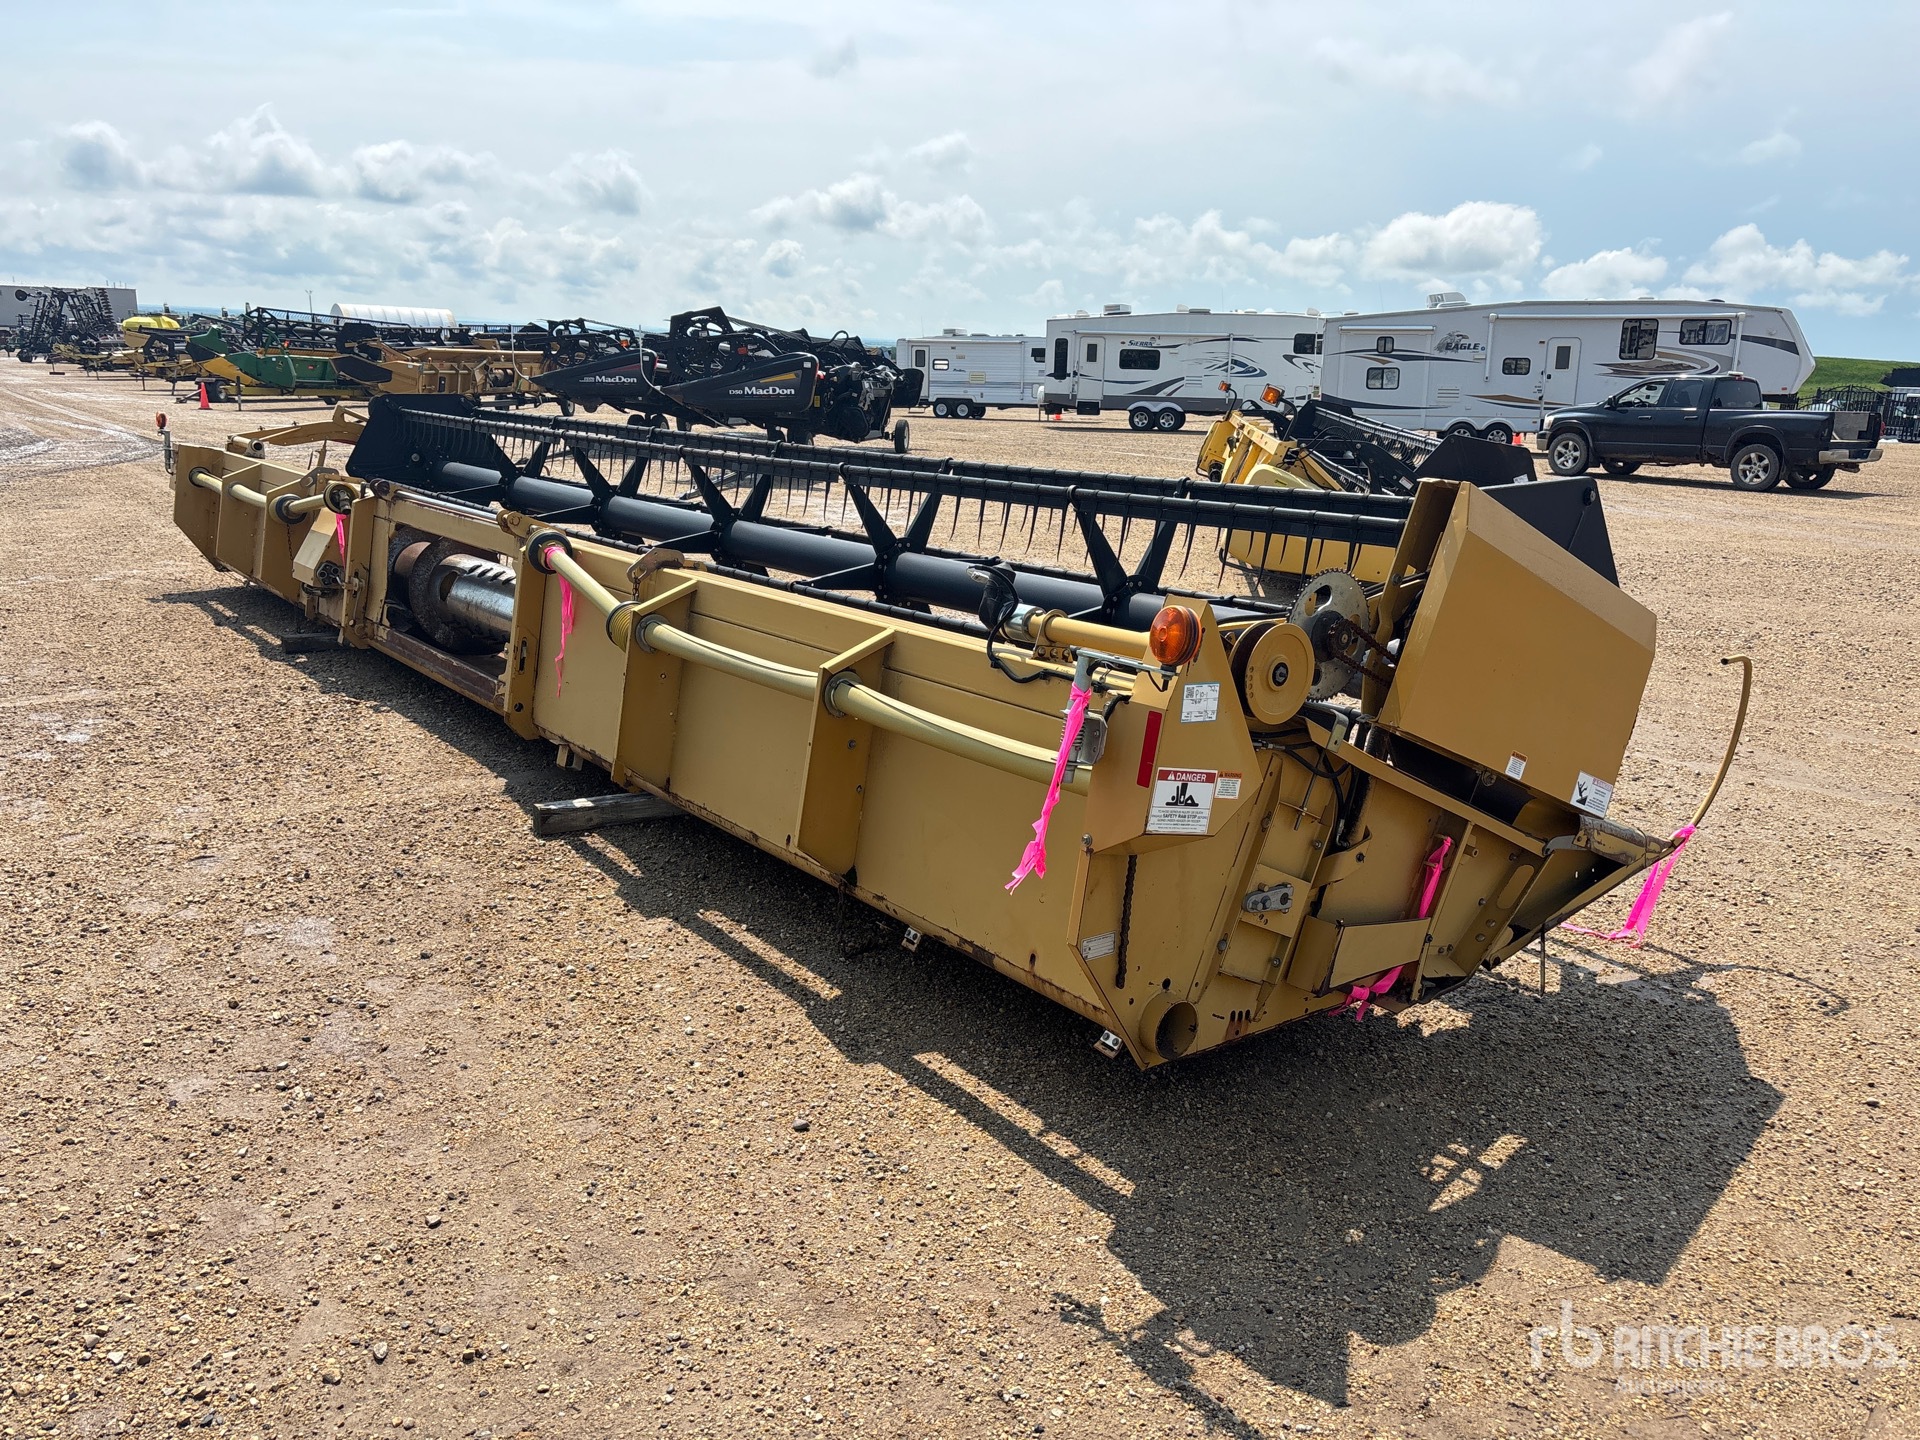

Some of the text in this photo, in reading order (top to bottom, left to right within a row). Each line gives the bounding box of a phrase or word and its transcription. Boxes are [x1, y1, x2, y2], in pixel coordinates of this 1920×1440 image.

[595, 375, 637, 383] MacDon
[744, 386, 795, 395] MacDon
[1176, 772, 1207, 782] DANGER
